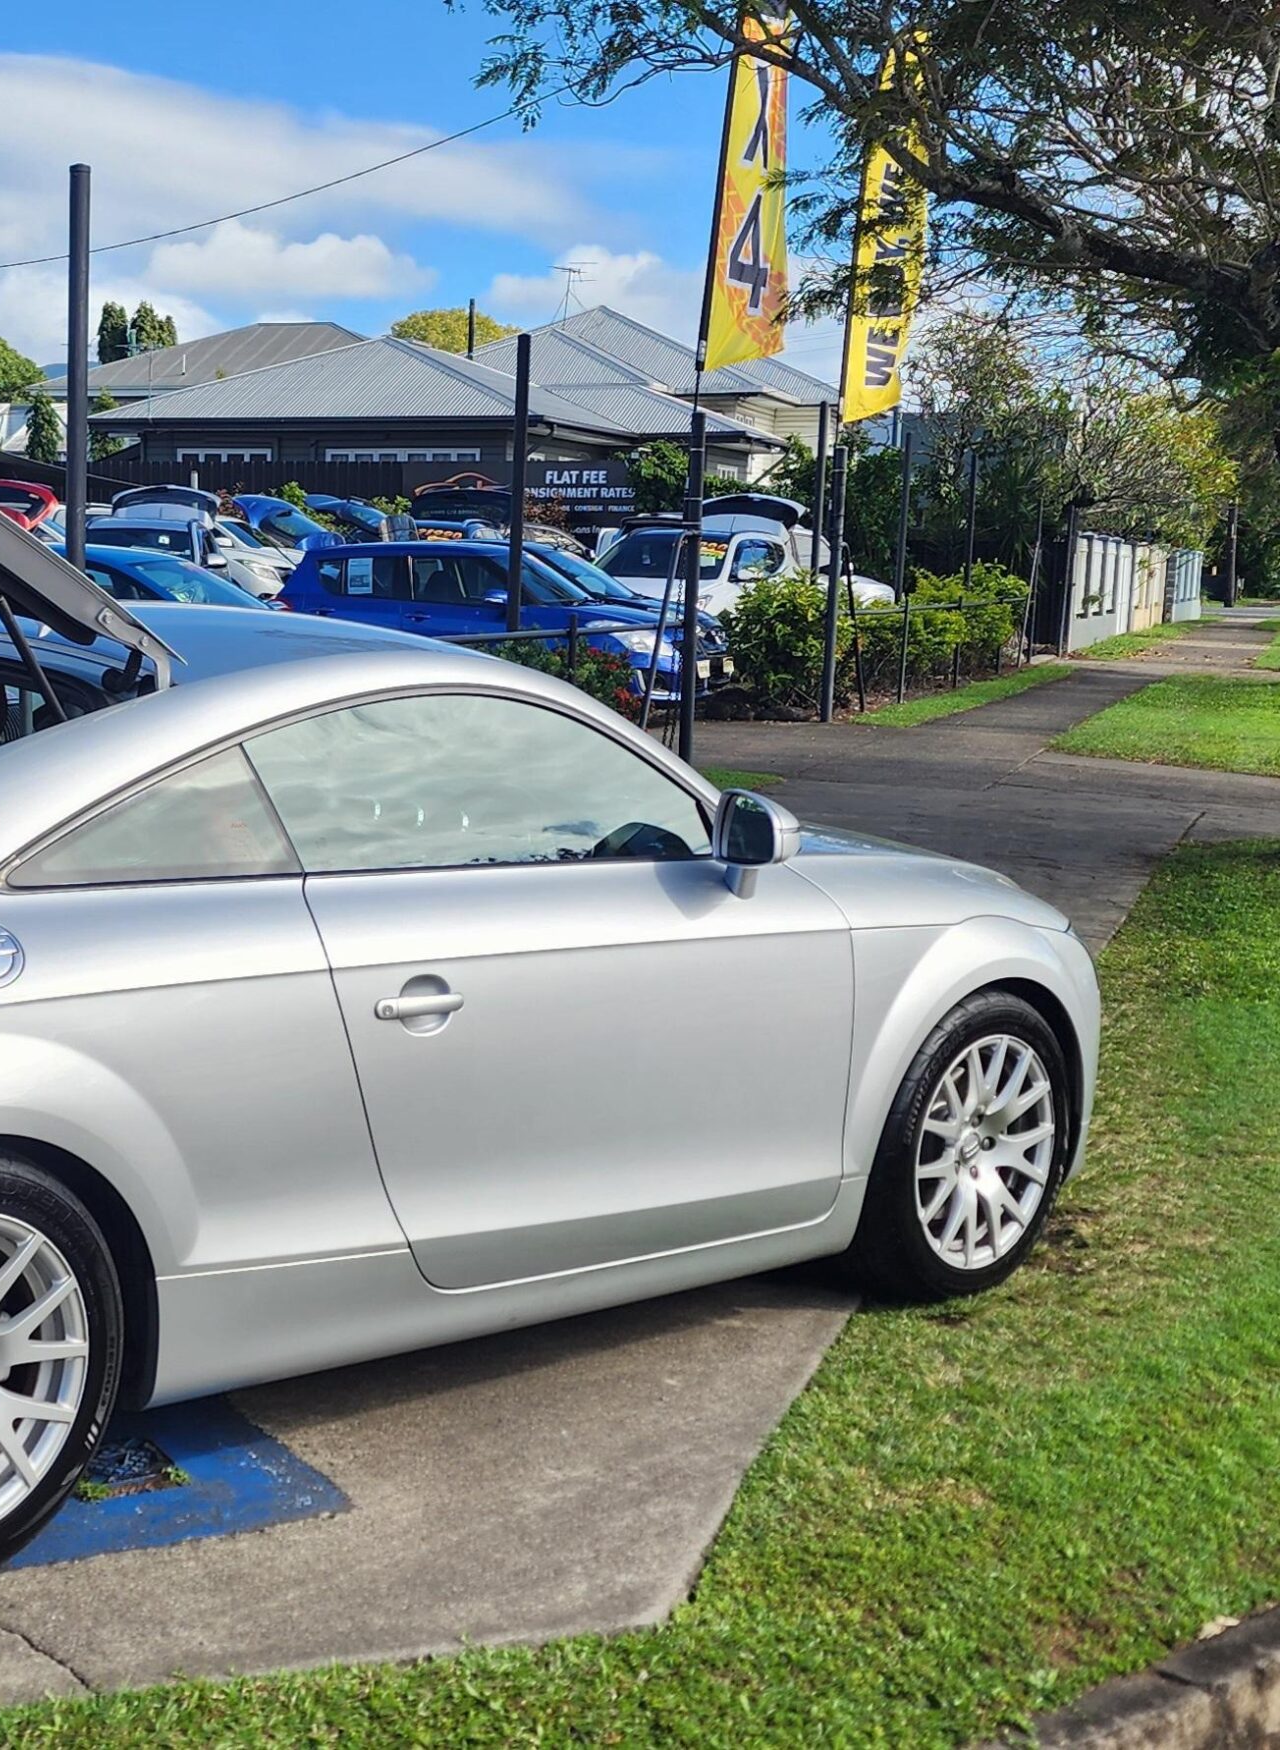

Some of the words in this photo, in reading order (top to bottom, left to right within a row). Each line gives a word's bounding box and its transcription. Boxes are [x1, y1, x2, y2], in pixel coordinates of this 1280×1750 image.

[545, 470, 580, 485] FLAT
[582, 470, 608, 485] FEE
[600, 487, 636, 498] RATES
